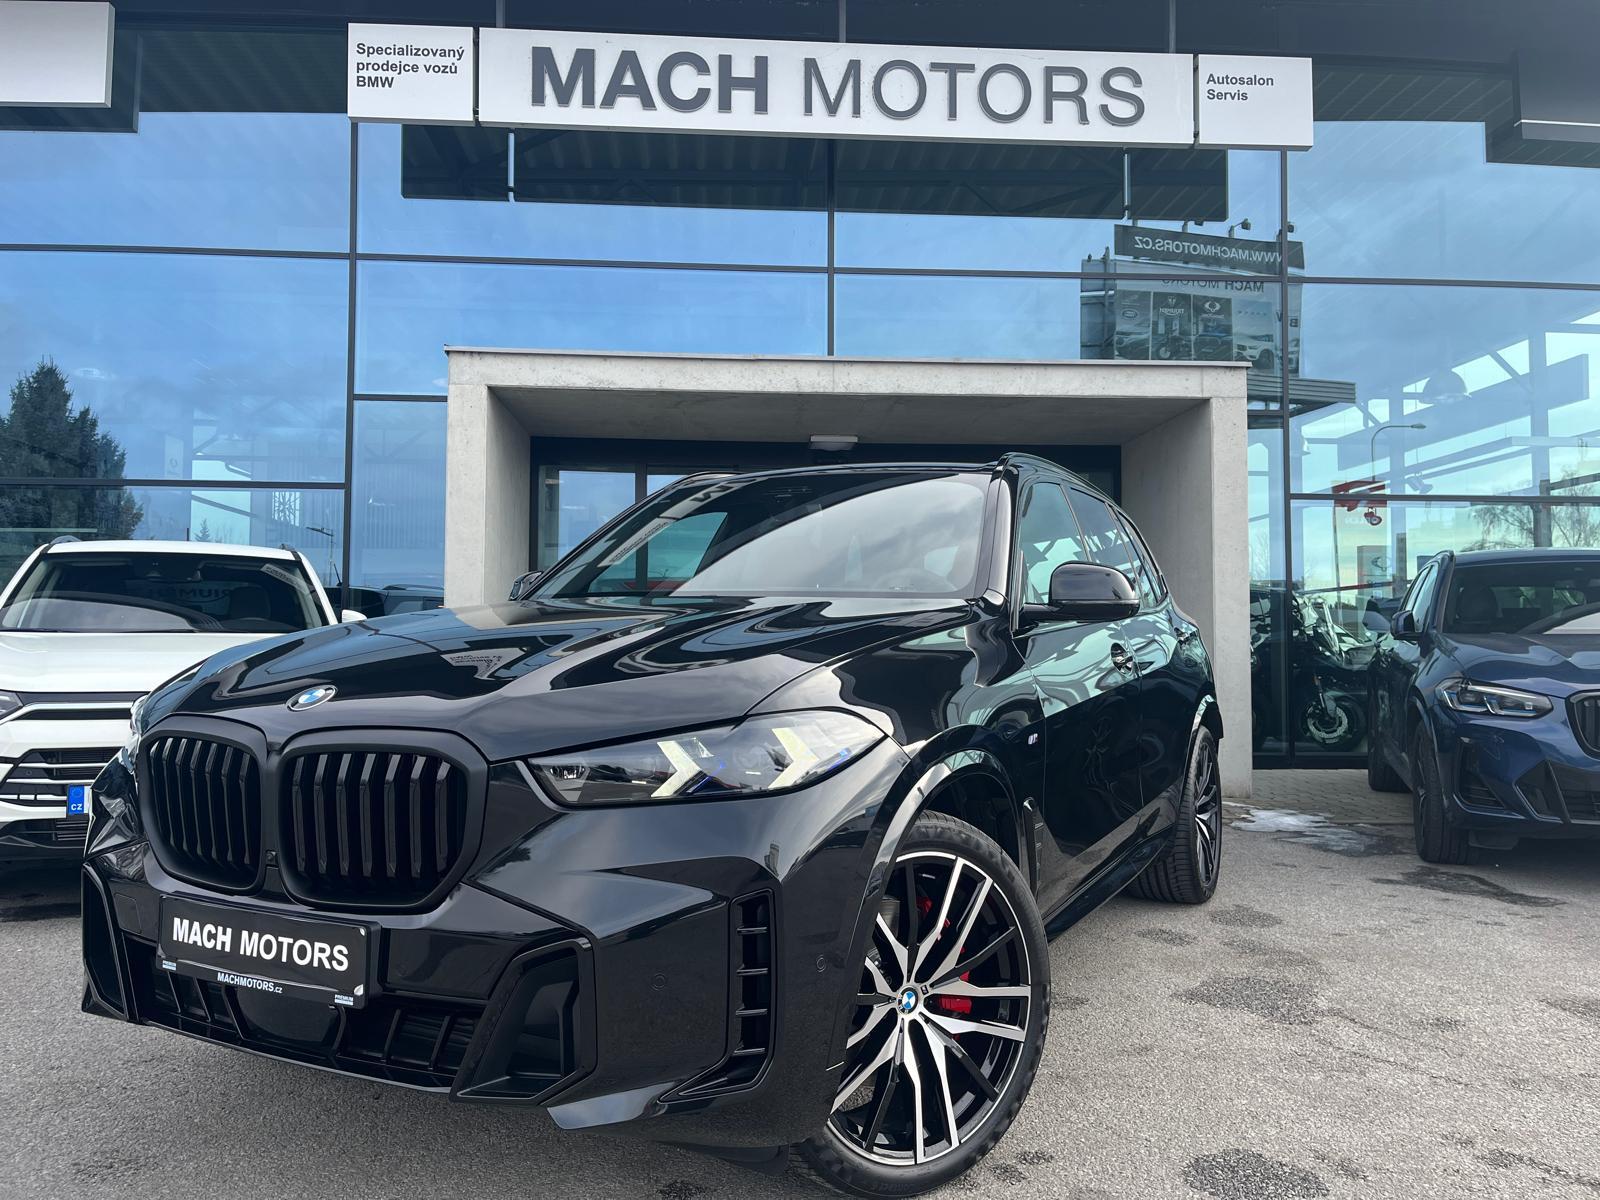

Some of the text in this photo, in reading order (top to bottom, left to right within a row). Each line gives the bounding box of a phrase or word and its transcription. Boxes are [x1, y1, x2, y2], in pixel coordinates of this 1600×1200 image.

[356, 42, 465, 61] Specializovaný
[356, 60, 458, 75] prodejce vozů
[356, 75, 394, 88] BMW
[531, 46, 1146, 127] MACH MOTORS
[1206, 73, 1274, 86] Autosalon
[1206, 88, 1248, 101] Servis
[71, 803, 83, 811] CZ
[172, 917, 349, 972] MACH MOTORS
